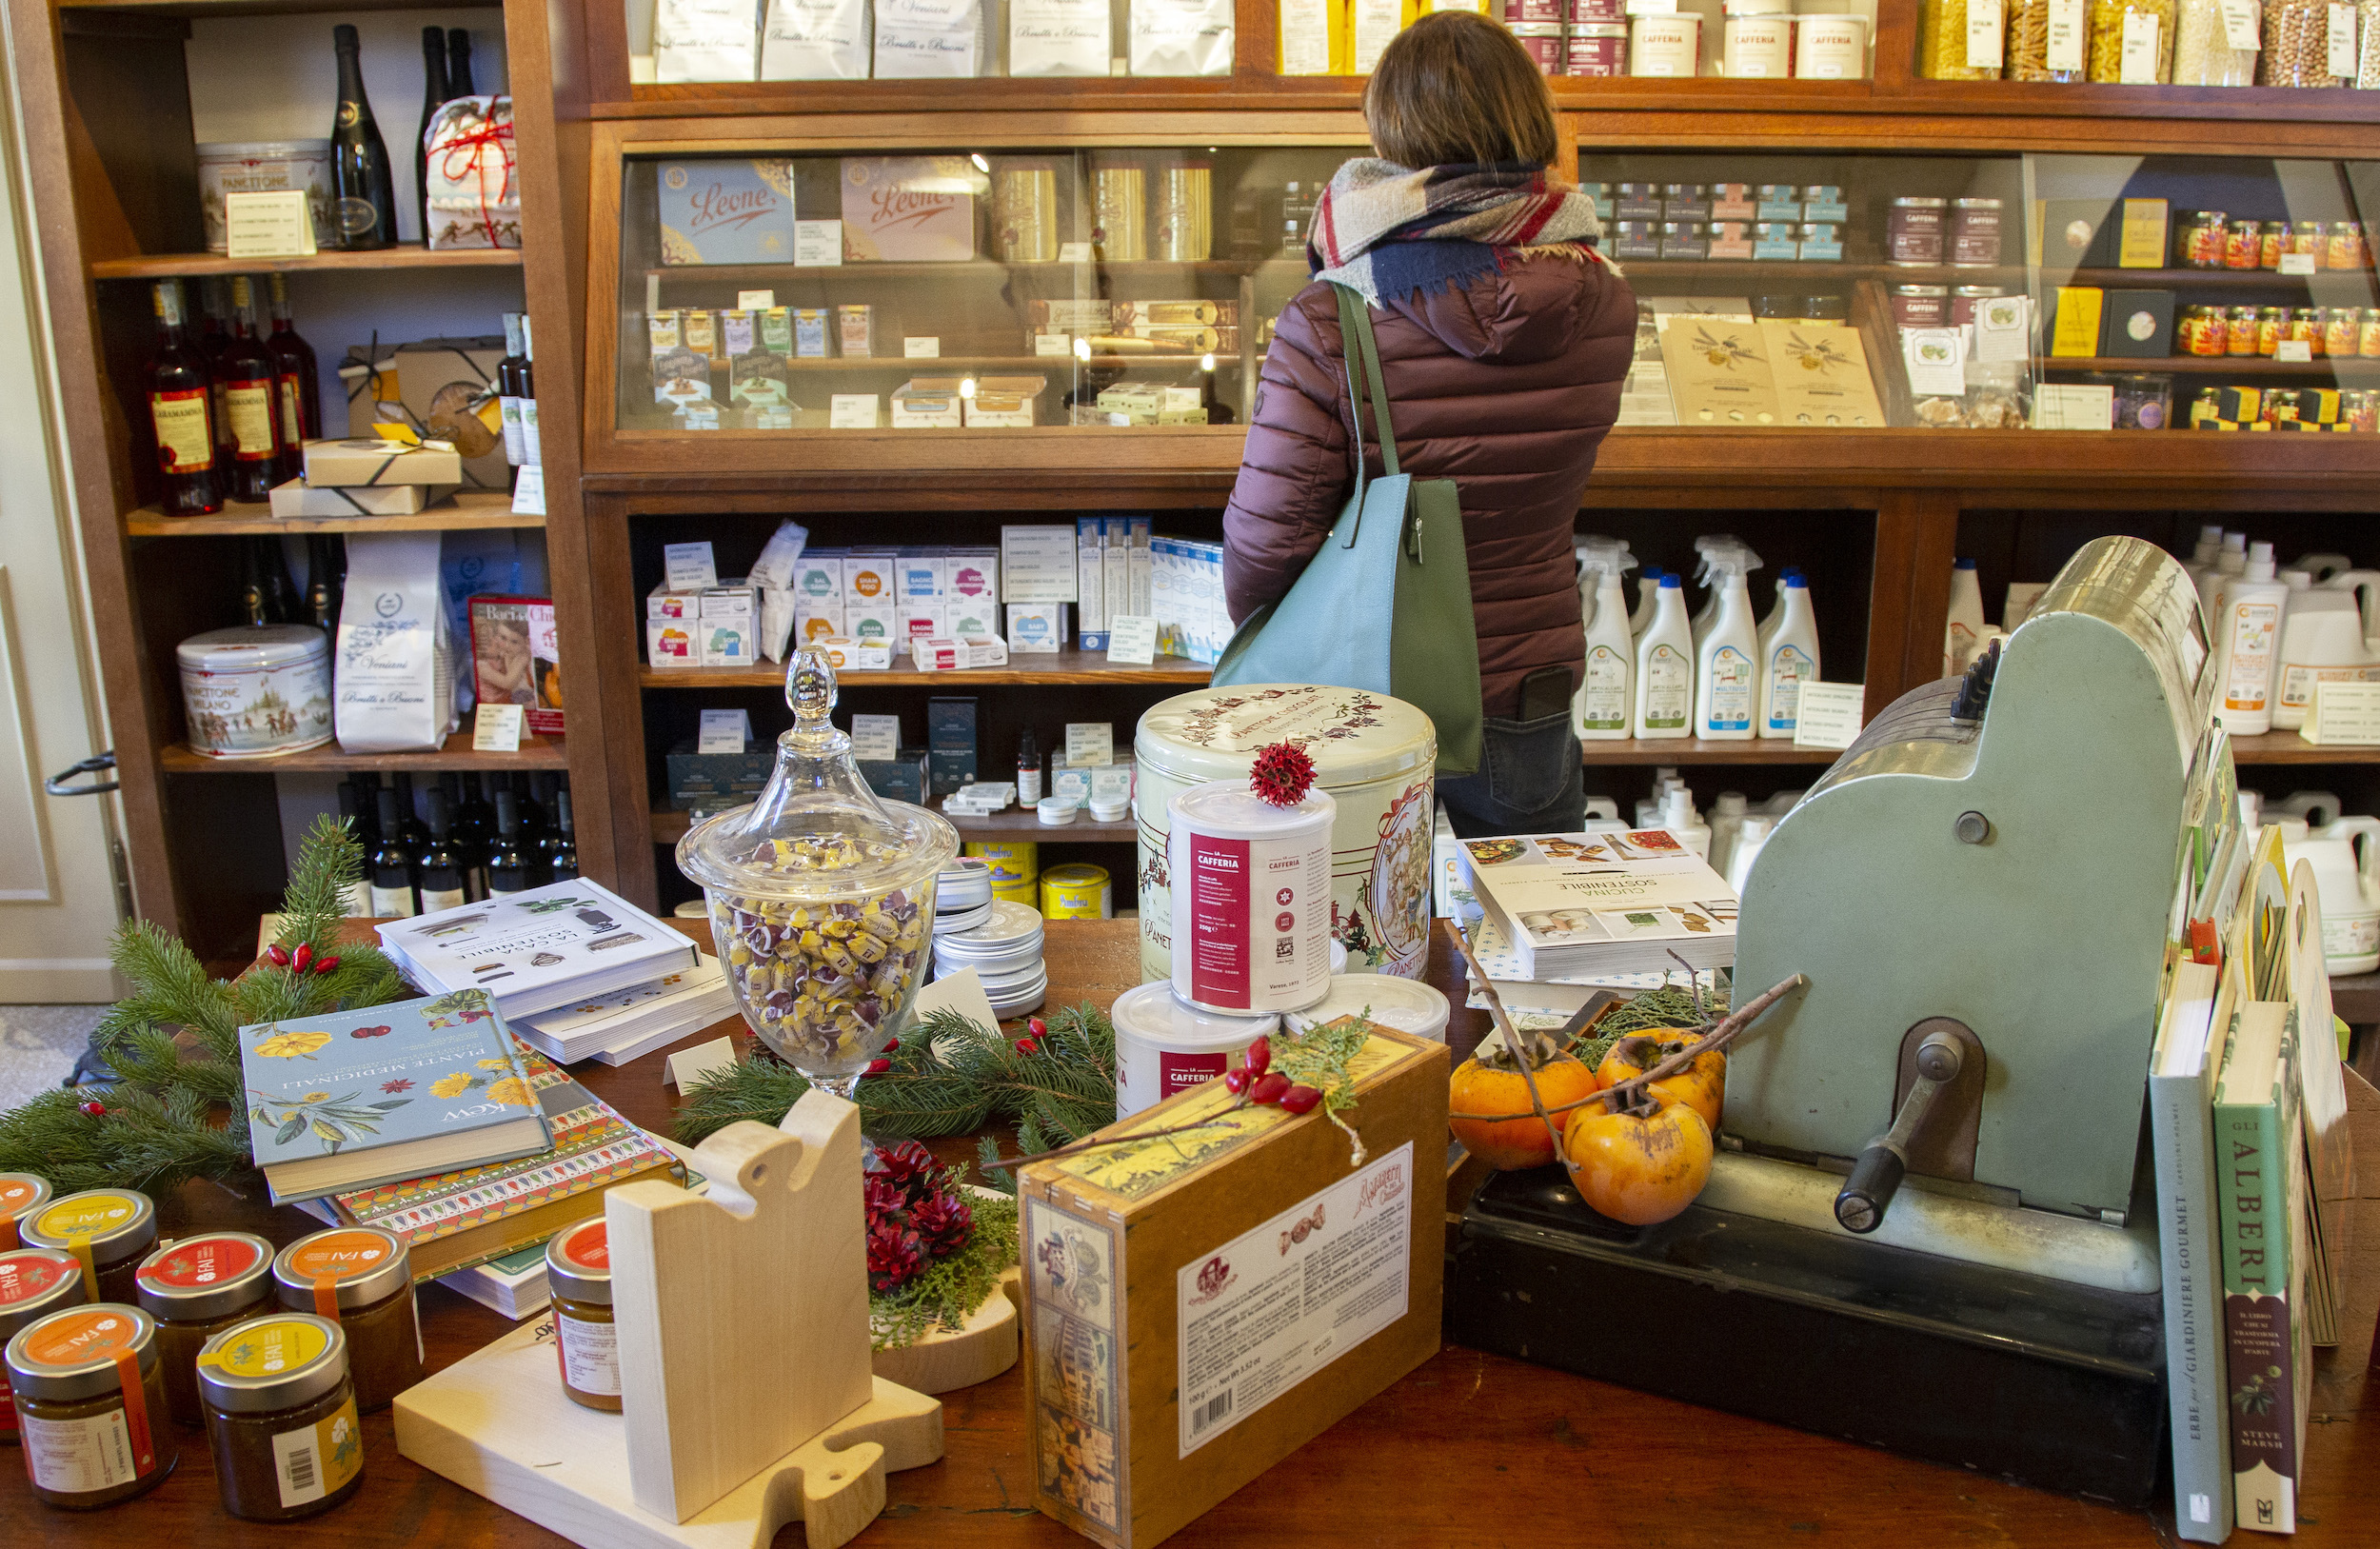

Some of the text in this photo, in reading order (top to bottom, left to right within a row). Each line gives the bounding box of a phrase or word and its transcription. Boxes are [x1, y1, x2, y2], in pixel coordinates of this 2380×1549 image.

[879, 34, 917, 49] Brutti
[928, 38, 966, 53] Buoni
[1642, 35, 1683, 45] CAFFERIA
[1735, 35, 1776, 45] CAFFERIA
[1811, 35, 1852, 46] CAFFERIA
[529, 606, 555, 621] Chi
[342, 691, 378, 705] Brutti
[390, 690, 426, 704] Buoni
[1198, 856, 1240, 868] CAFFERIA
[1269, 860, 1300, 869] CAFFERIA
[1557, 879, 1657, 890] SOSTENIBILE
[1582, 887, 1645, 897] CUCINA
[1144, 918, 1172, 950] PANET
[1199, 924, 1212, 933] 250g
[455, 929, 572, 960] SOSTENIBILE
[503, 941, 549, 954] CASA
[1387, 947, 1426, 976] PANETTON
[412, 1048, 486, 1067] PIANTE
[283, 1062, 407, 1090] MEDICINALI
[1170, 1072, 1216, 1082] CAFFERIA
[2232, 1121, 2260, 1131] GLI
[78, 1211, 105, 1223] FAI
[2233, 1140, 2267, 1286] ALBERI
[2176, 1195, 2191, 1269] GOURMET
[331, 1251, 359, 1261] FAI
[196, 1258, 215, 1274] FAI
[3, 1273, 19, 1289] FAI
[2180, 1276, 2196, 1373] GIARDINIERE
[69, 1328, 101, 1346] FAI
[265, 1343, 283, 1360] FAI
[1219, 1375, 1230, 1386] Net
[1240, 1360, 1253, 1374] 3.52
[2190, 1405, 2201, 1440] ERBE
[2242, 1430, 2281, 1440] STEVE
[2241, 1439, 2283, 1448] MARSH
